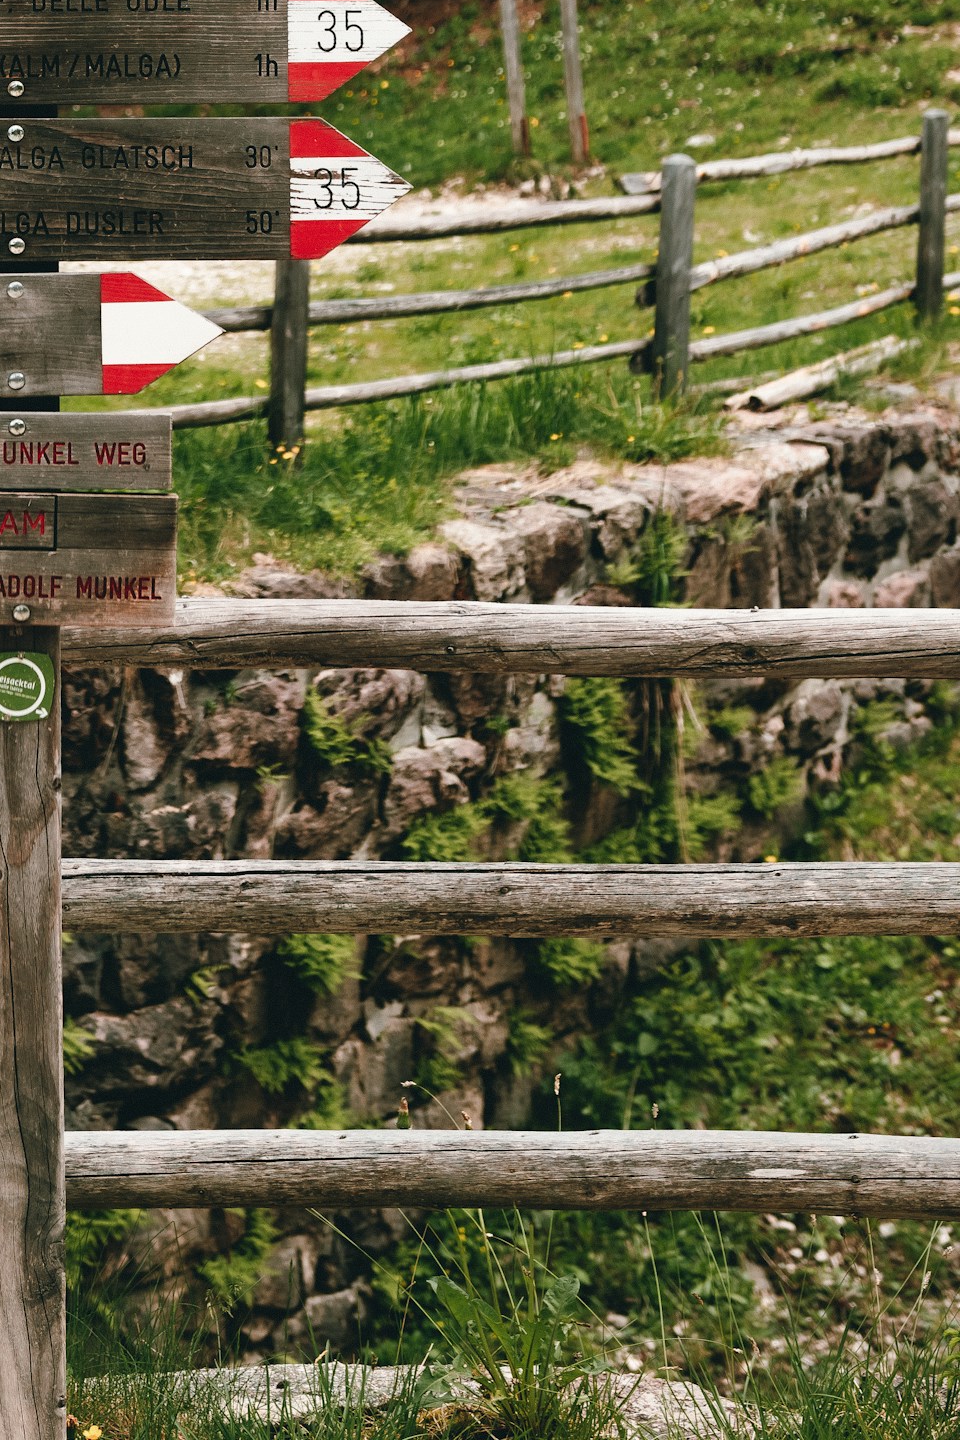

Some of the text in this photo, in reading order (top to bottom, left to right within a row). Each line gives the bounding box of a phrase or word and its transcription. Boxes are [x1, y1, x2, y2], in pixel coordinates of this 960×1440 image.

[317, 10, 364, 52] 35
[253, 53, 279, 77] 1h
[81, 145, 194, 170] GLATSCH
[313, 167, 361, 210] 35
[66, 210, 165, 235] DUSLER
[94, 441, 147, 466] WEG
[75, 576, 162, 600] MUNKEL
